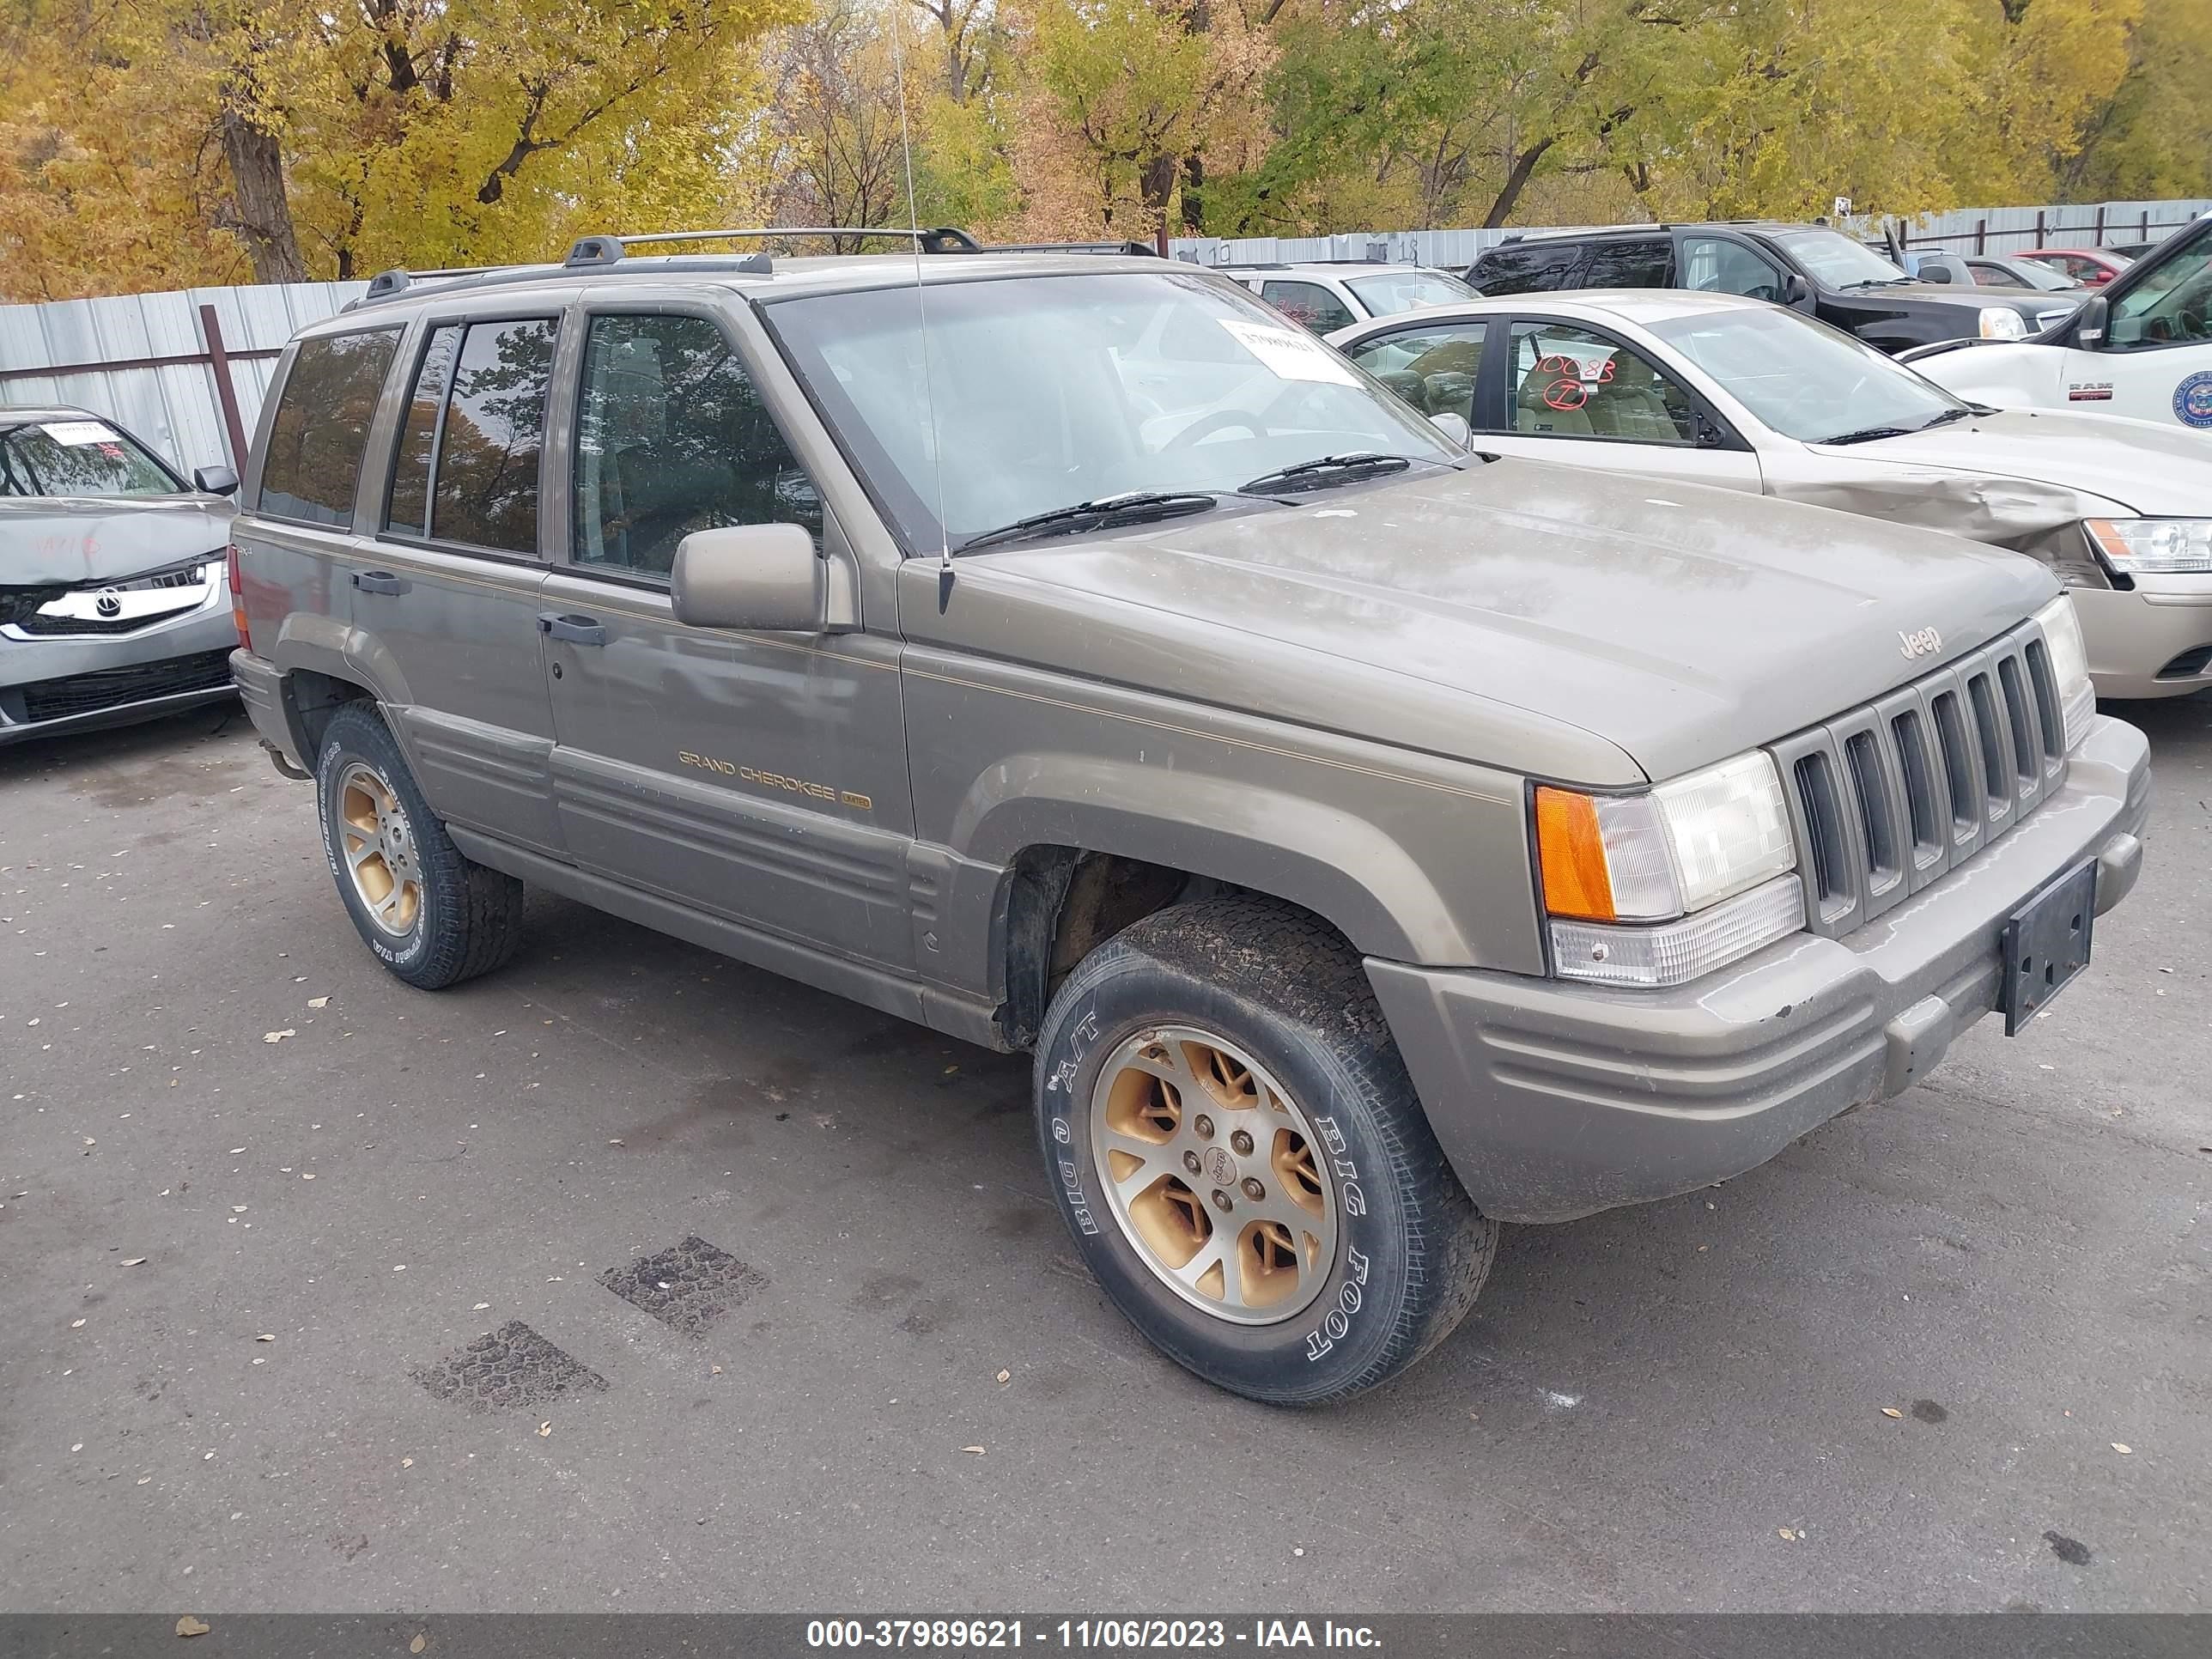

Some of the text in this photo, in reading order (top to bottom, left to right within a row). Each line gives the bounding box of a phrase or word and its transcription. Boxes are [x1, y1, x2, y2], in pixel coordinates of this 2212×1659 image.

[1535, 351, 1616, 384] 10083
[1897, 625, 1942, 660] Jeep
[678, 750, 836, 802] GRAND CHEROKEE
[842, 793, 870, 808] LIMITED
[395, 935, 422, 964] Trail
[1052, 1010, 1100, 1236] BIG O A/T
[1212, 1152, 1226, 1182] Jeep
[1306, 1116, 1370, 1362] BIG FOOT
